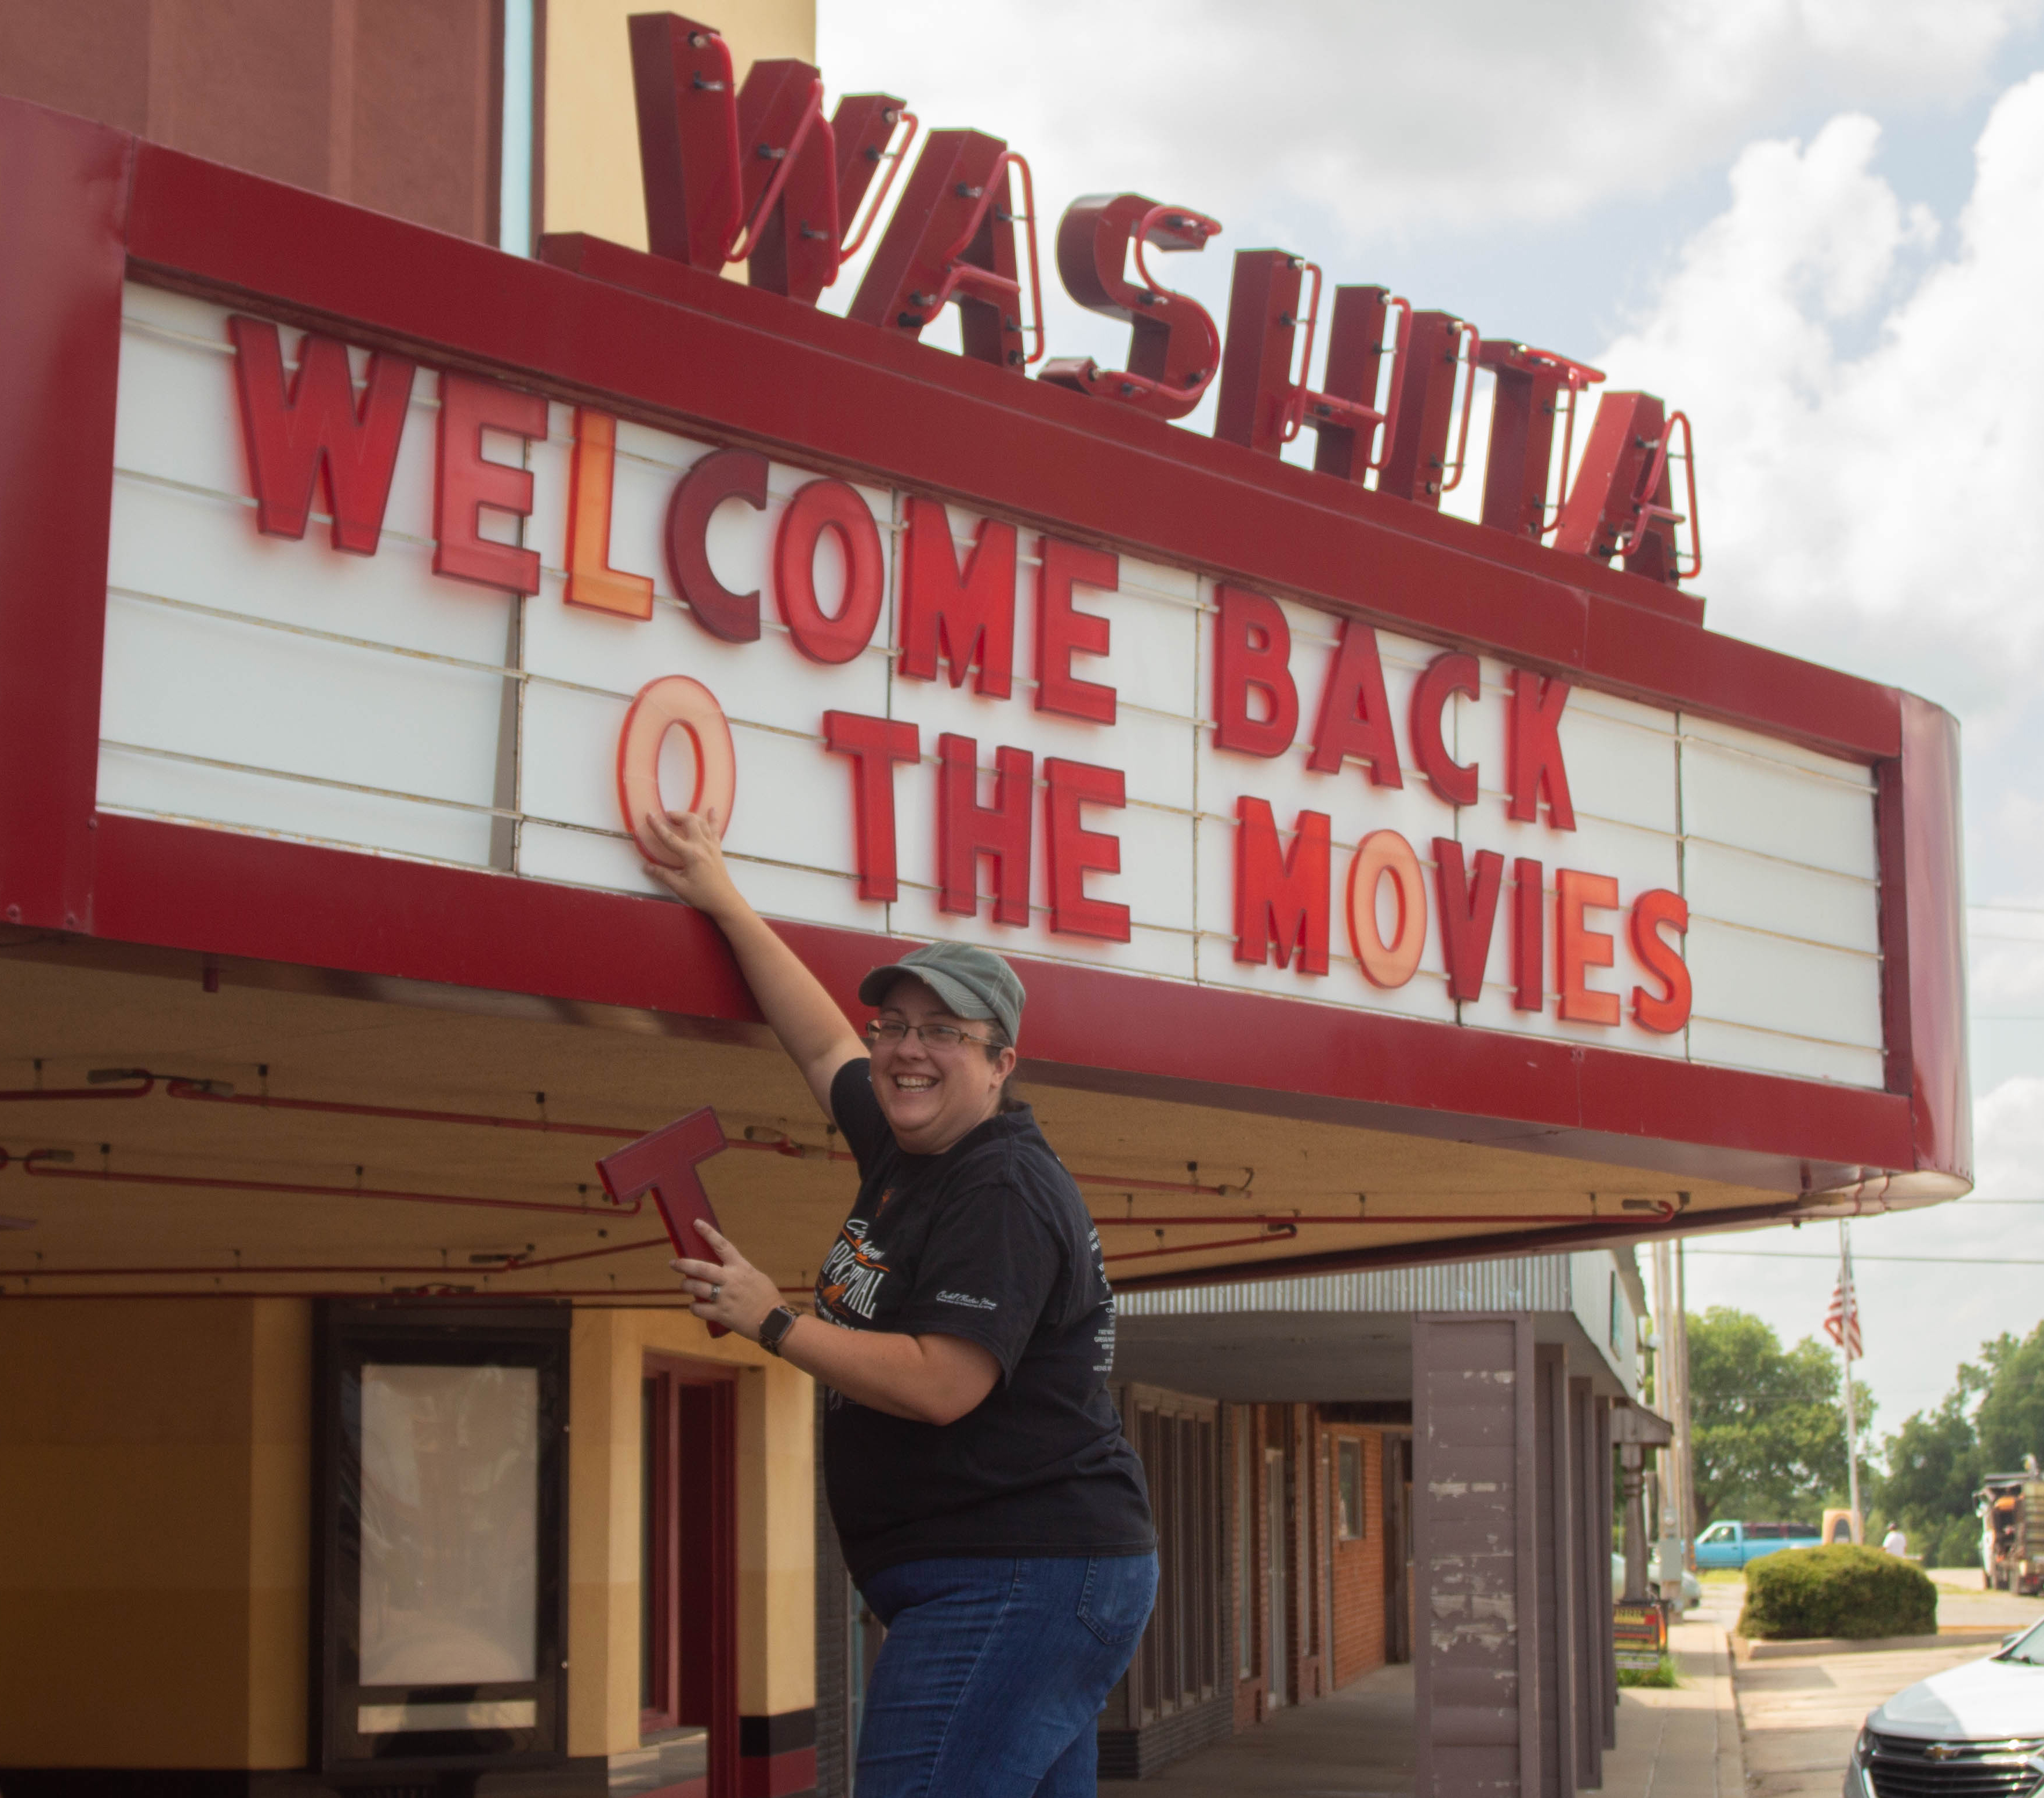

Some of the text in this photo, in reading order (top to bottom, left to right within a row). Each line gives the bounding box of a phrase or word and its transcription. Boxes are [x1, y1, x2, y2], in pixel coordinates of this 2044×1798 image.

[628, 10, 1703, 586] WASHITA
[227, 313, 1577, 833] WELCOME BACK
[616, 674, 1693, 1034] O THE MOVIES
